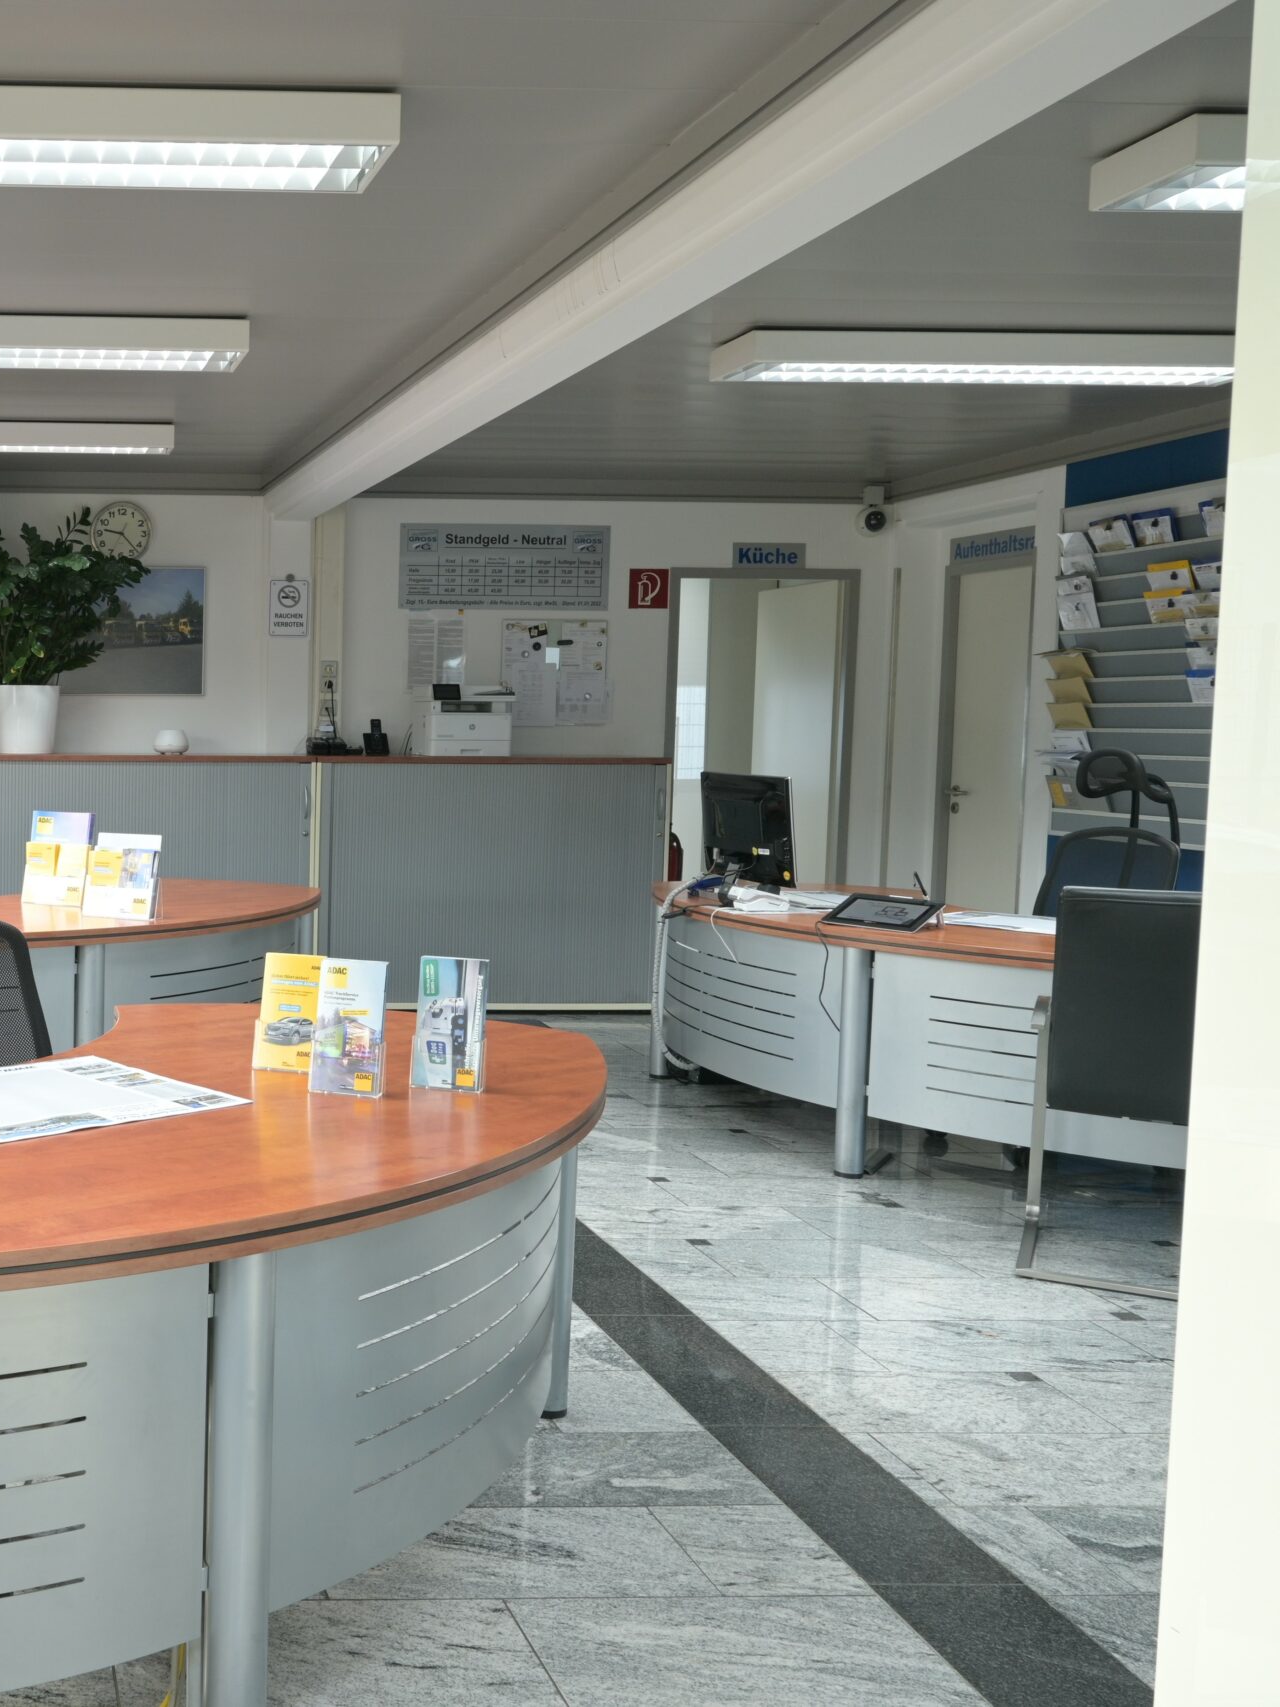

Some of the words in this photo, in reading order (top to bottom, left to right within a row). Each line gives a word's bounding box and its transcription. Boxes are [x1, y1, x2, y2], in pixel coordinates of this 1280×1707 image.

[117, 508, 128, 516] 12
[100, 518, 110, 526] 10
[137, 519, 145, 527] 2
[96, 529, 103, 537] 9
[140, 530, 147, 538] 3
[445, 533, 509, 547] Standgeld
[521, 534, 567, 546] Neutral
[574, 537, 602, 545] GROSS
[128, 549, 135, 557] 5
[738, 547, 798, 564] Küche
[327, 966, 348, 975] ADAC
[457, 1068, 474, 1076] ADAC
